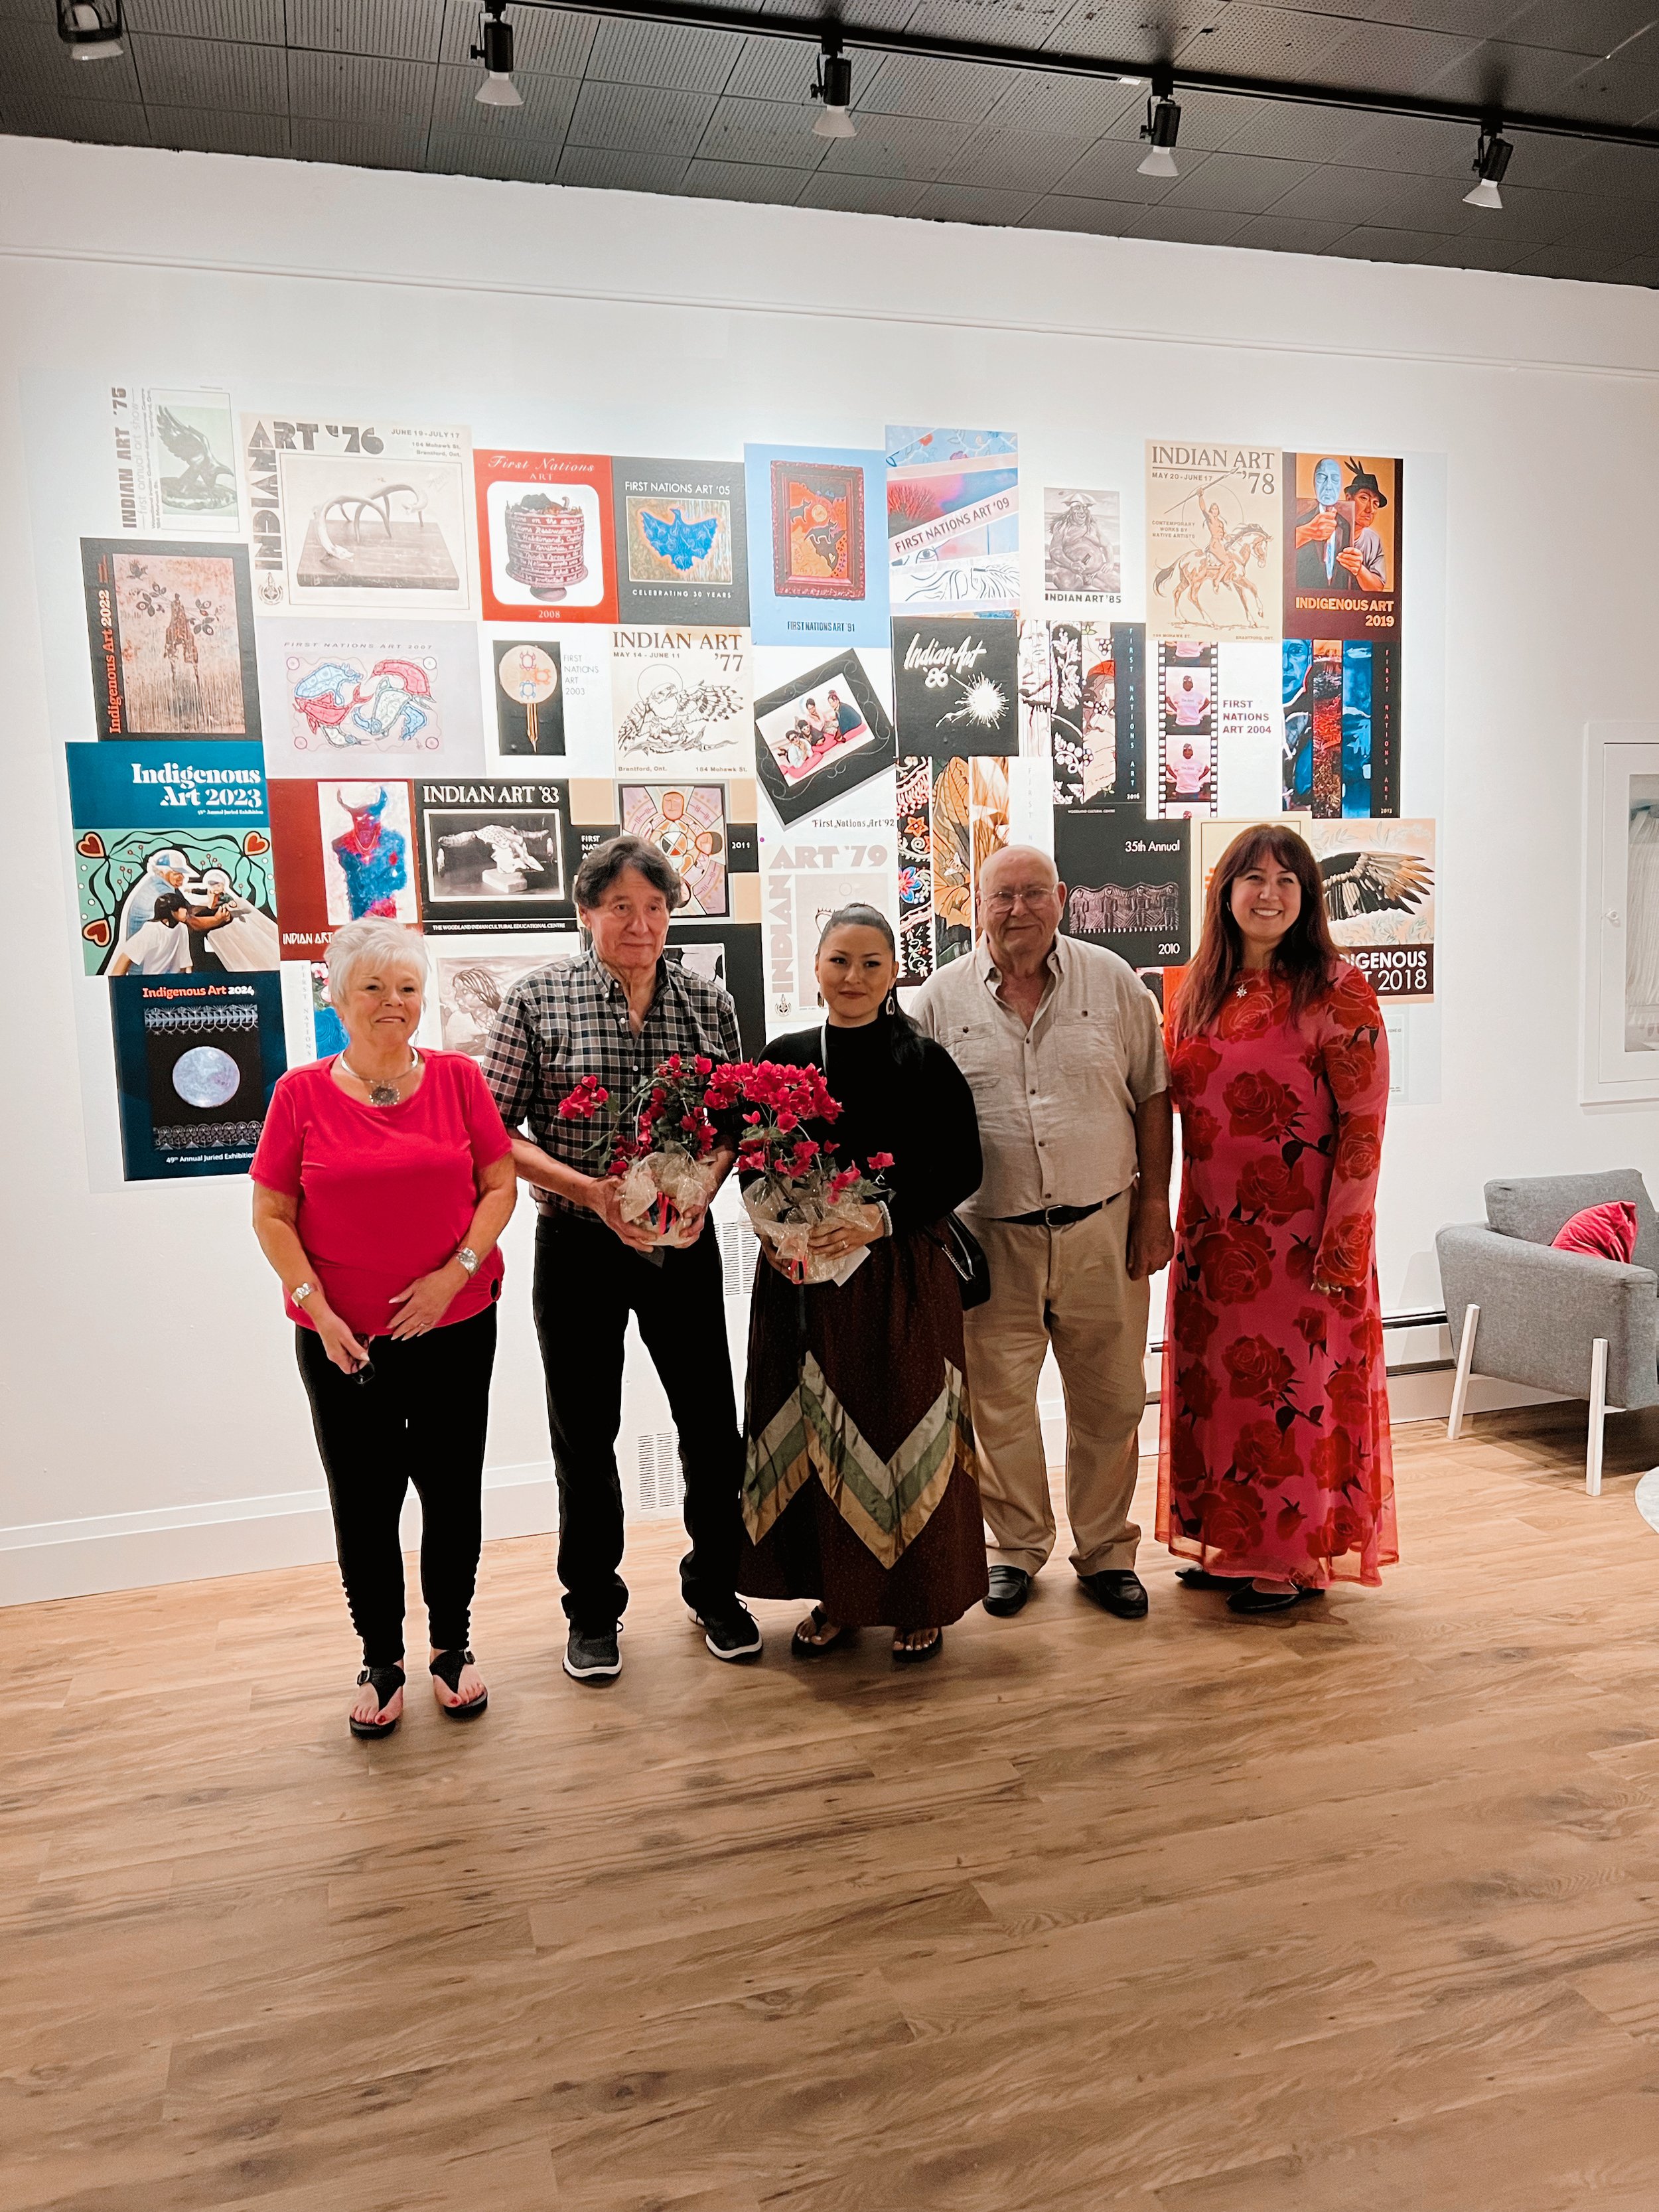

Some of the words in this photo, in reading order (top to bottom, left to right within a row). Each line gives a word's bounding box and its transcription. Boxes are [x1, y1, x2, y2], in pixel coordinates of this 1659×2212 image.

[111, 387, 127, 415] '75
[130, 403, 141, 430] show
[115, 427, 131, 460] ART
[133, 433, 142, 450] art
[248, 420, 319, 451] ART
[325, 425, 384, 455] '76
[488, 455, 529, 469] First
[535, 458, 595, 473] Nations
[1152, 446, 1228, 467] INDIAN
[1234, 451, 1275, 469] ART
[135, 456, 145, 492] annual
[1242, 471, 1275, 494] '78
[118, 469, 137, 528] INDIAN
[624, 481, 648, 491] FIRST
[650, 482, 692, 494] NATIONS
[695, 484, 713, 494] ART
[716, 486, 731, 495] '05
[137, 496, 148, 514] first
[248, 449, 283, 571] INDIAN
[895, 532, 924, 553] FIRST
[926, 513, 971, 540] NATIONS
[973, 504, 992, 521] ART
[993, 497, 1010, 510] '09
[99, 589, 112, 627] 2022
[1045, 593, 1082, 602] INDIAN
[1106, 595, 1121, 603] '85
[1295, 597, 1368, 611] INDIGENOUS
[1369, 600, 1394, 612] ART
[538, 610, 561, 619] 2008
[1365, 615, 1394, 627] 2019
[787, 621, 804, 630] FIRST
[806, 622, 832, 631] NATIONS
[833, 623, 845, 632] ART
[102, 629, 115, 653] Art
[613, 631, 691, 649] INDIAN
[699, 633, 742, 650] ART
[715, 653, 743, 672] '77
[903, 633, 954, 670] Indian
[952, 636, 987, 674] Art
[922, 666, 949, 688] '86
[106, 654, 123, 734] Indigenous
[131, 762, 261, 790] Indigenous
[160, 786, 201, 806] Art
[205, 788, 261, 808] 2023
[423, 786, 495, 803] INDIAN
[498, 786, 535, 803] ART
[538, 786, 559, 803] '83
[812, 819, 833, 828] First
[834, 819, 865, 828] Nations
[867, 819, 882, 828] Art
[769, 845, 839, 869] ART
[844, 844, 888, 867] '79
[1125, 840, 1146, 852] 35th
[1148, 840, 1180, 851] Annual
[283, 932, 313, 946] INDIAN
[315, 932, 333, 944] ART
[768, 875, 794, 993] INDIAN
[1158, 943, 1181, 954] 2010
[1339, 950, 1427, 969] IGENOUS
[1378, 968, 1427, 991] 2018
[142, 987, 206, 999] Indigenous
[208, 986, 227, 995] Art
[228, 986, 255, 996] 2024
[204, 1153, 224, 1162] Juried
